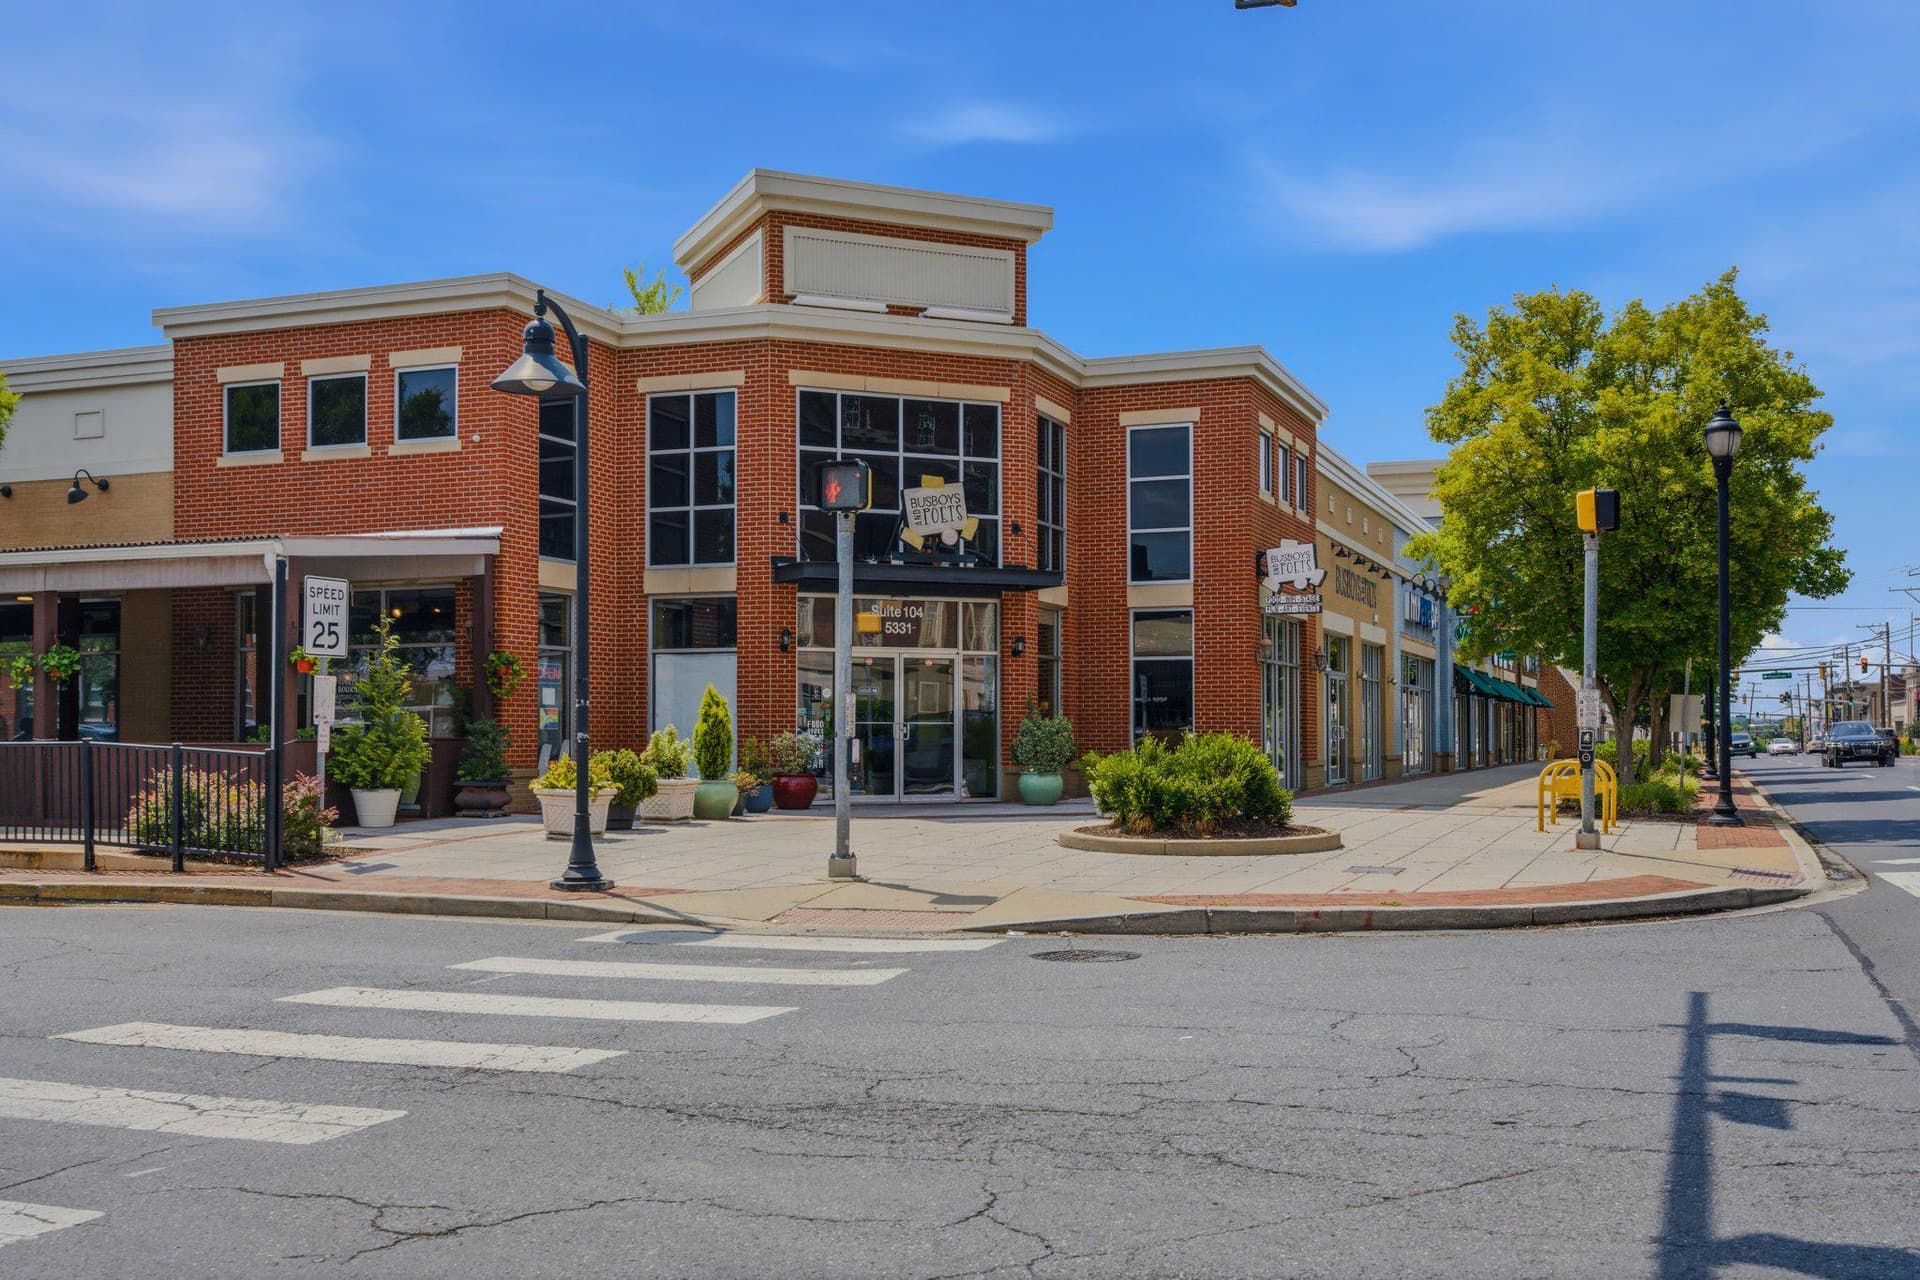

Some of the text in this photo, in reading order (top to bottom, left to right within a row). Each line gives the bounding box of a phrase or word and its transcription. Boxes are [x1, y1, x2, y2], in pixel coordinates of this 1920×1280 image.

[910, 492, 961, 509] BUSBOYS
[912, 504, 963, 526] AND POETS
[1271, 550, 1311, 563] BUSBOYS
[1280, 560, 1313, 575] POETS
[309, 586, 345, 600] SPEED
[312, 603, 340, 616] LIMIT
[871, 604, 923, 618] Suite 104
[1283, 605, 1293, 613] ART
[312, 621, 340, 649] 25
